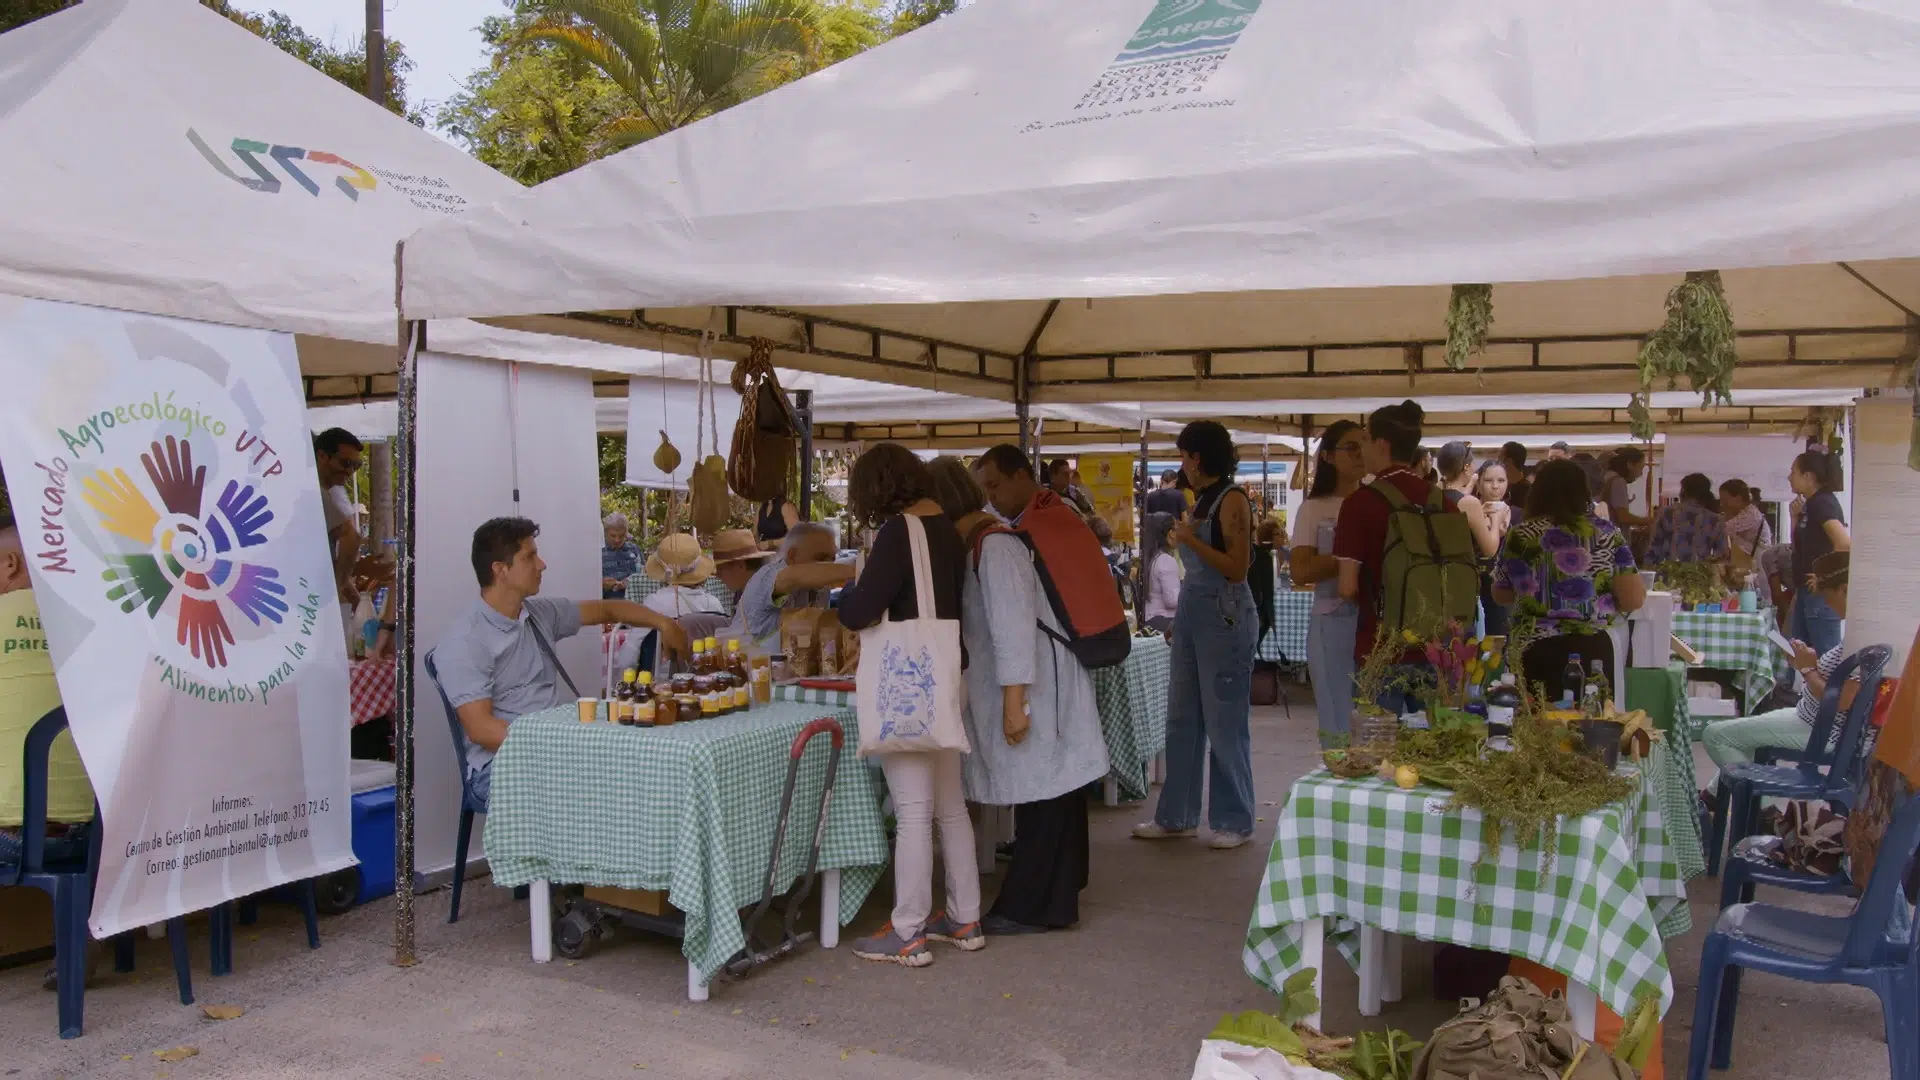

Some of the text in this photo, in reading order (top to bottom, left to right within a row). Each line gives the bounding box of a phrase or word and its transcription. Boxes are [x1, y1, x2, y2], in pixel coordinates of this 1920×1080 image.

[34, 390, 283, 574] Mercado Agroecológico UTP
[257, 661, 294, 705] para
[285, 641, 307, 660] la
[125, 840, 150, 858] Centro
[152, 832, 162, 850] de
[165, 825, 201, 846] Gestión
[254, 808, 291, 827] Teléfono:
[292, 803, 306, 820] 313
[308, 801, 318, 816] 72
[319, 797, 330, 812] 45
[212, 795, 254, 813] Informes:
[146, 825, 308, 875] Correo: gestionambiental@utp.edu.co
